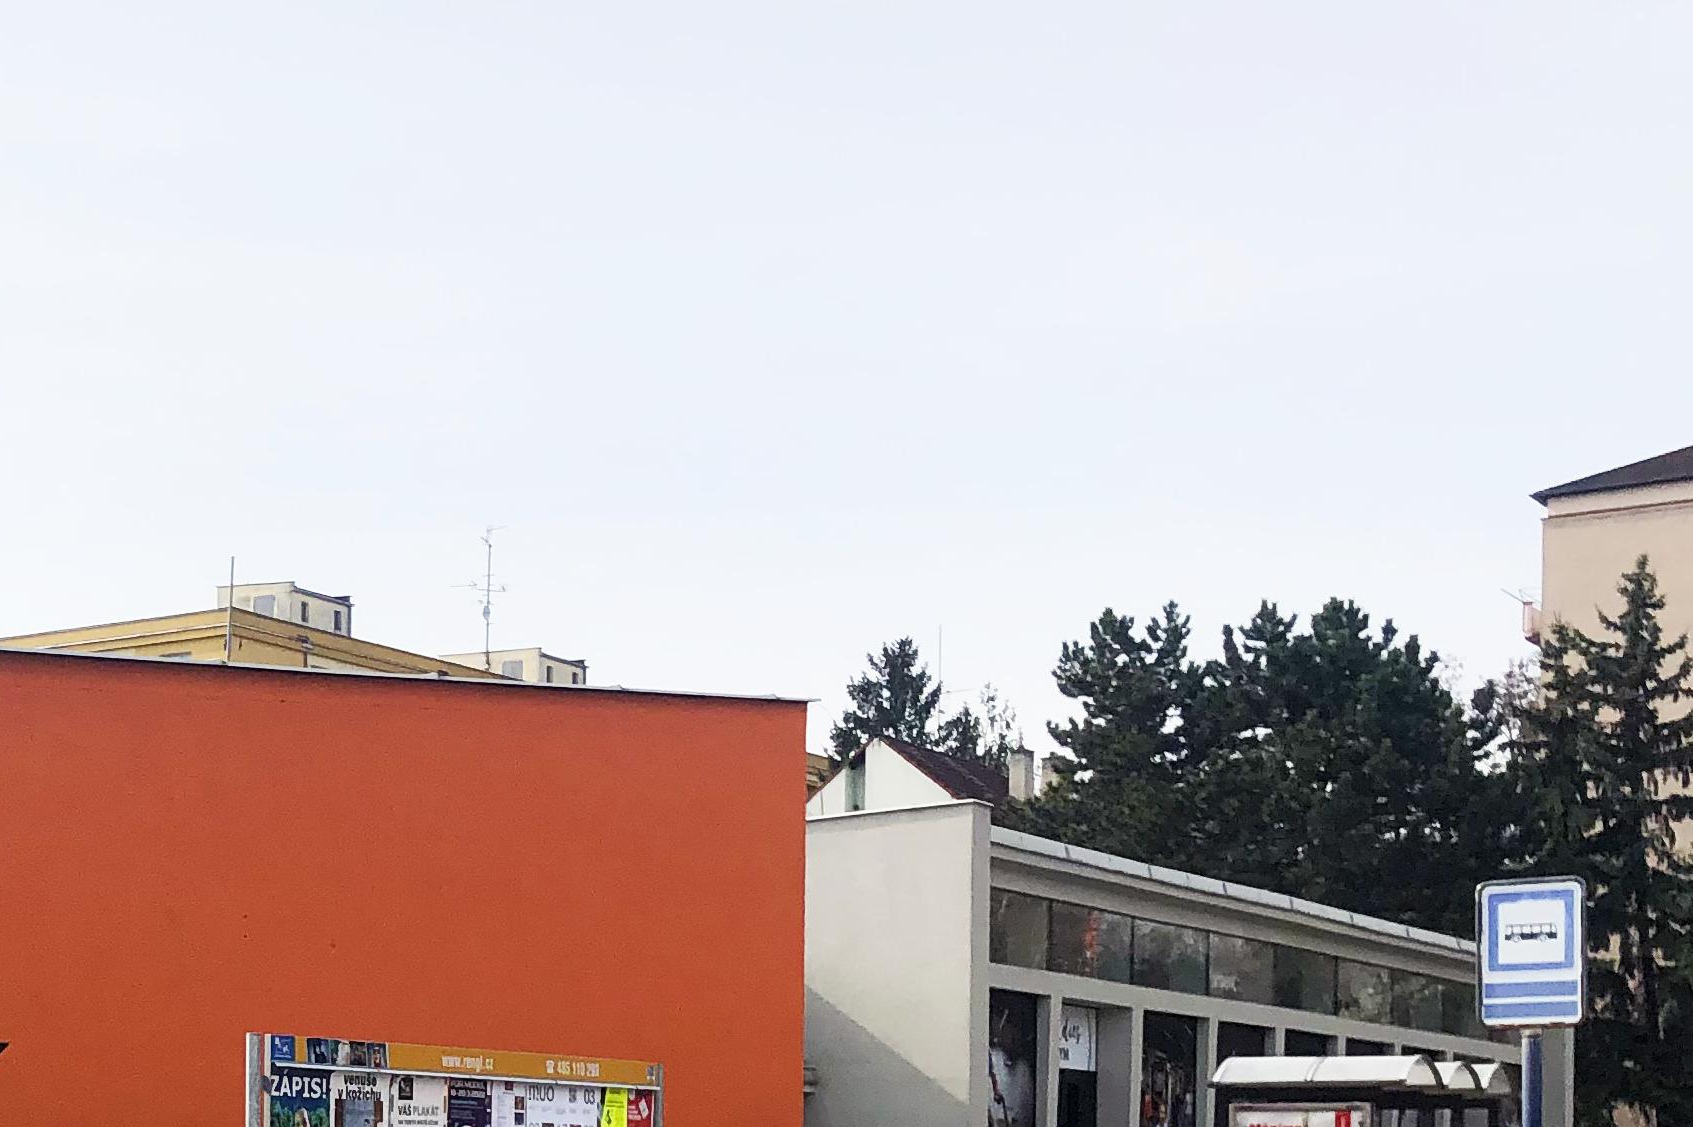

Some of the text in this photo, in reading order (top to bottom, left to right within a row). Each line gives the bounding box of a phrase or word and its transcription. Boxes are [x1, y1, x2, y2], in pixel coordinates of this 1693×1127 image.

[270, 1069, 327, 1099] ZÁPIS!
[345, 1086, 382, 1101] kožichu
[583, 1088, 596, 1104] 03
[398, 1104, 439, 1117] VÁŠ PLAKÁT
